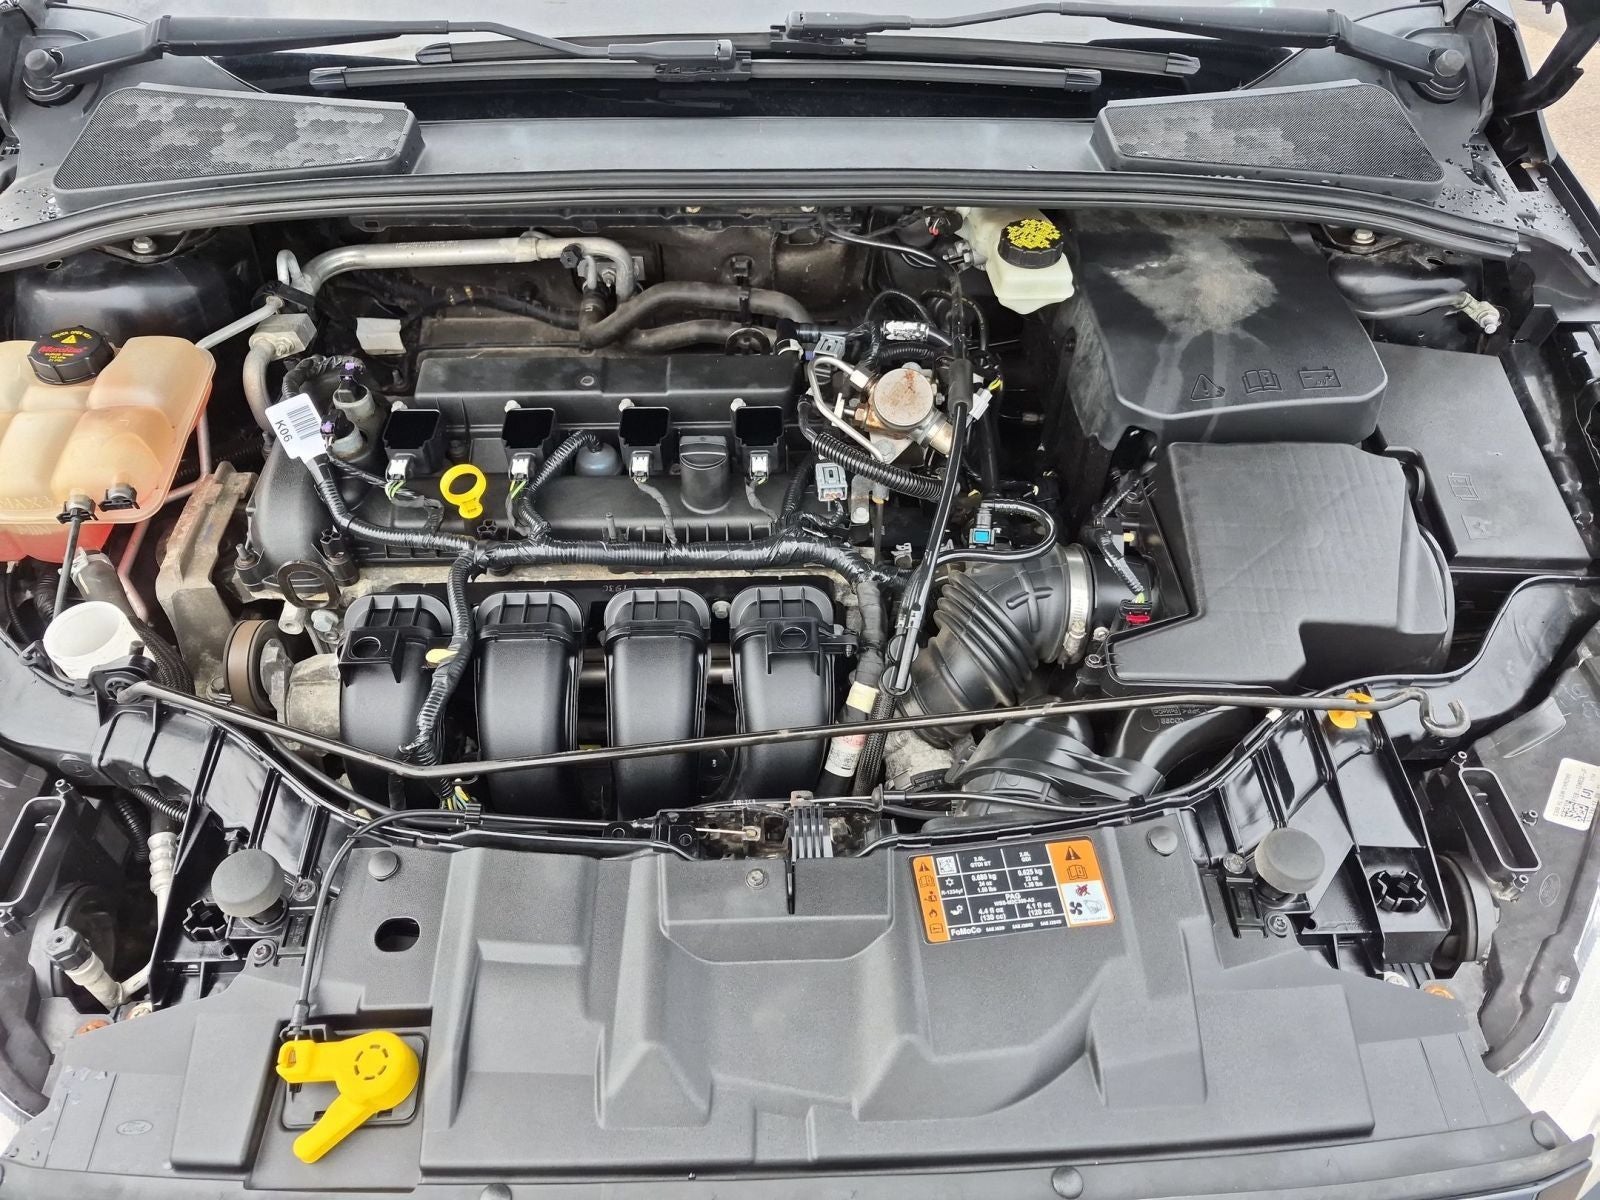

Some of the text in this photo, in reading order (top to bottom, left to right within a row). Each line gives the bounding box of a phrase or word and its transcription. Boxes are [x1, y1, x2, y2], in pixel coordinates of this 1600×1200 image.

[275, 420, 293, 442] K06
[1033, 868, 1043, 876] kg
[987, 873, 997, 881] kg
[1005, 893, 1021, 901] PAG
[1026, 902, 1036, 910] 4.1
[978, 907, 989, 915] 4.4
[1028, 907, 1054, 917] (120 cc)
[980, 913, 1006, 922] (130 cc)
[951, 926, 982, 936] FoMoCo
